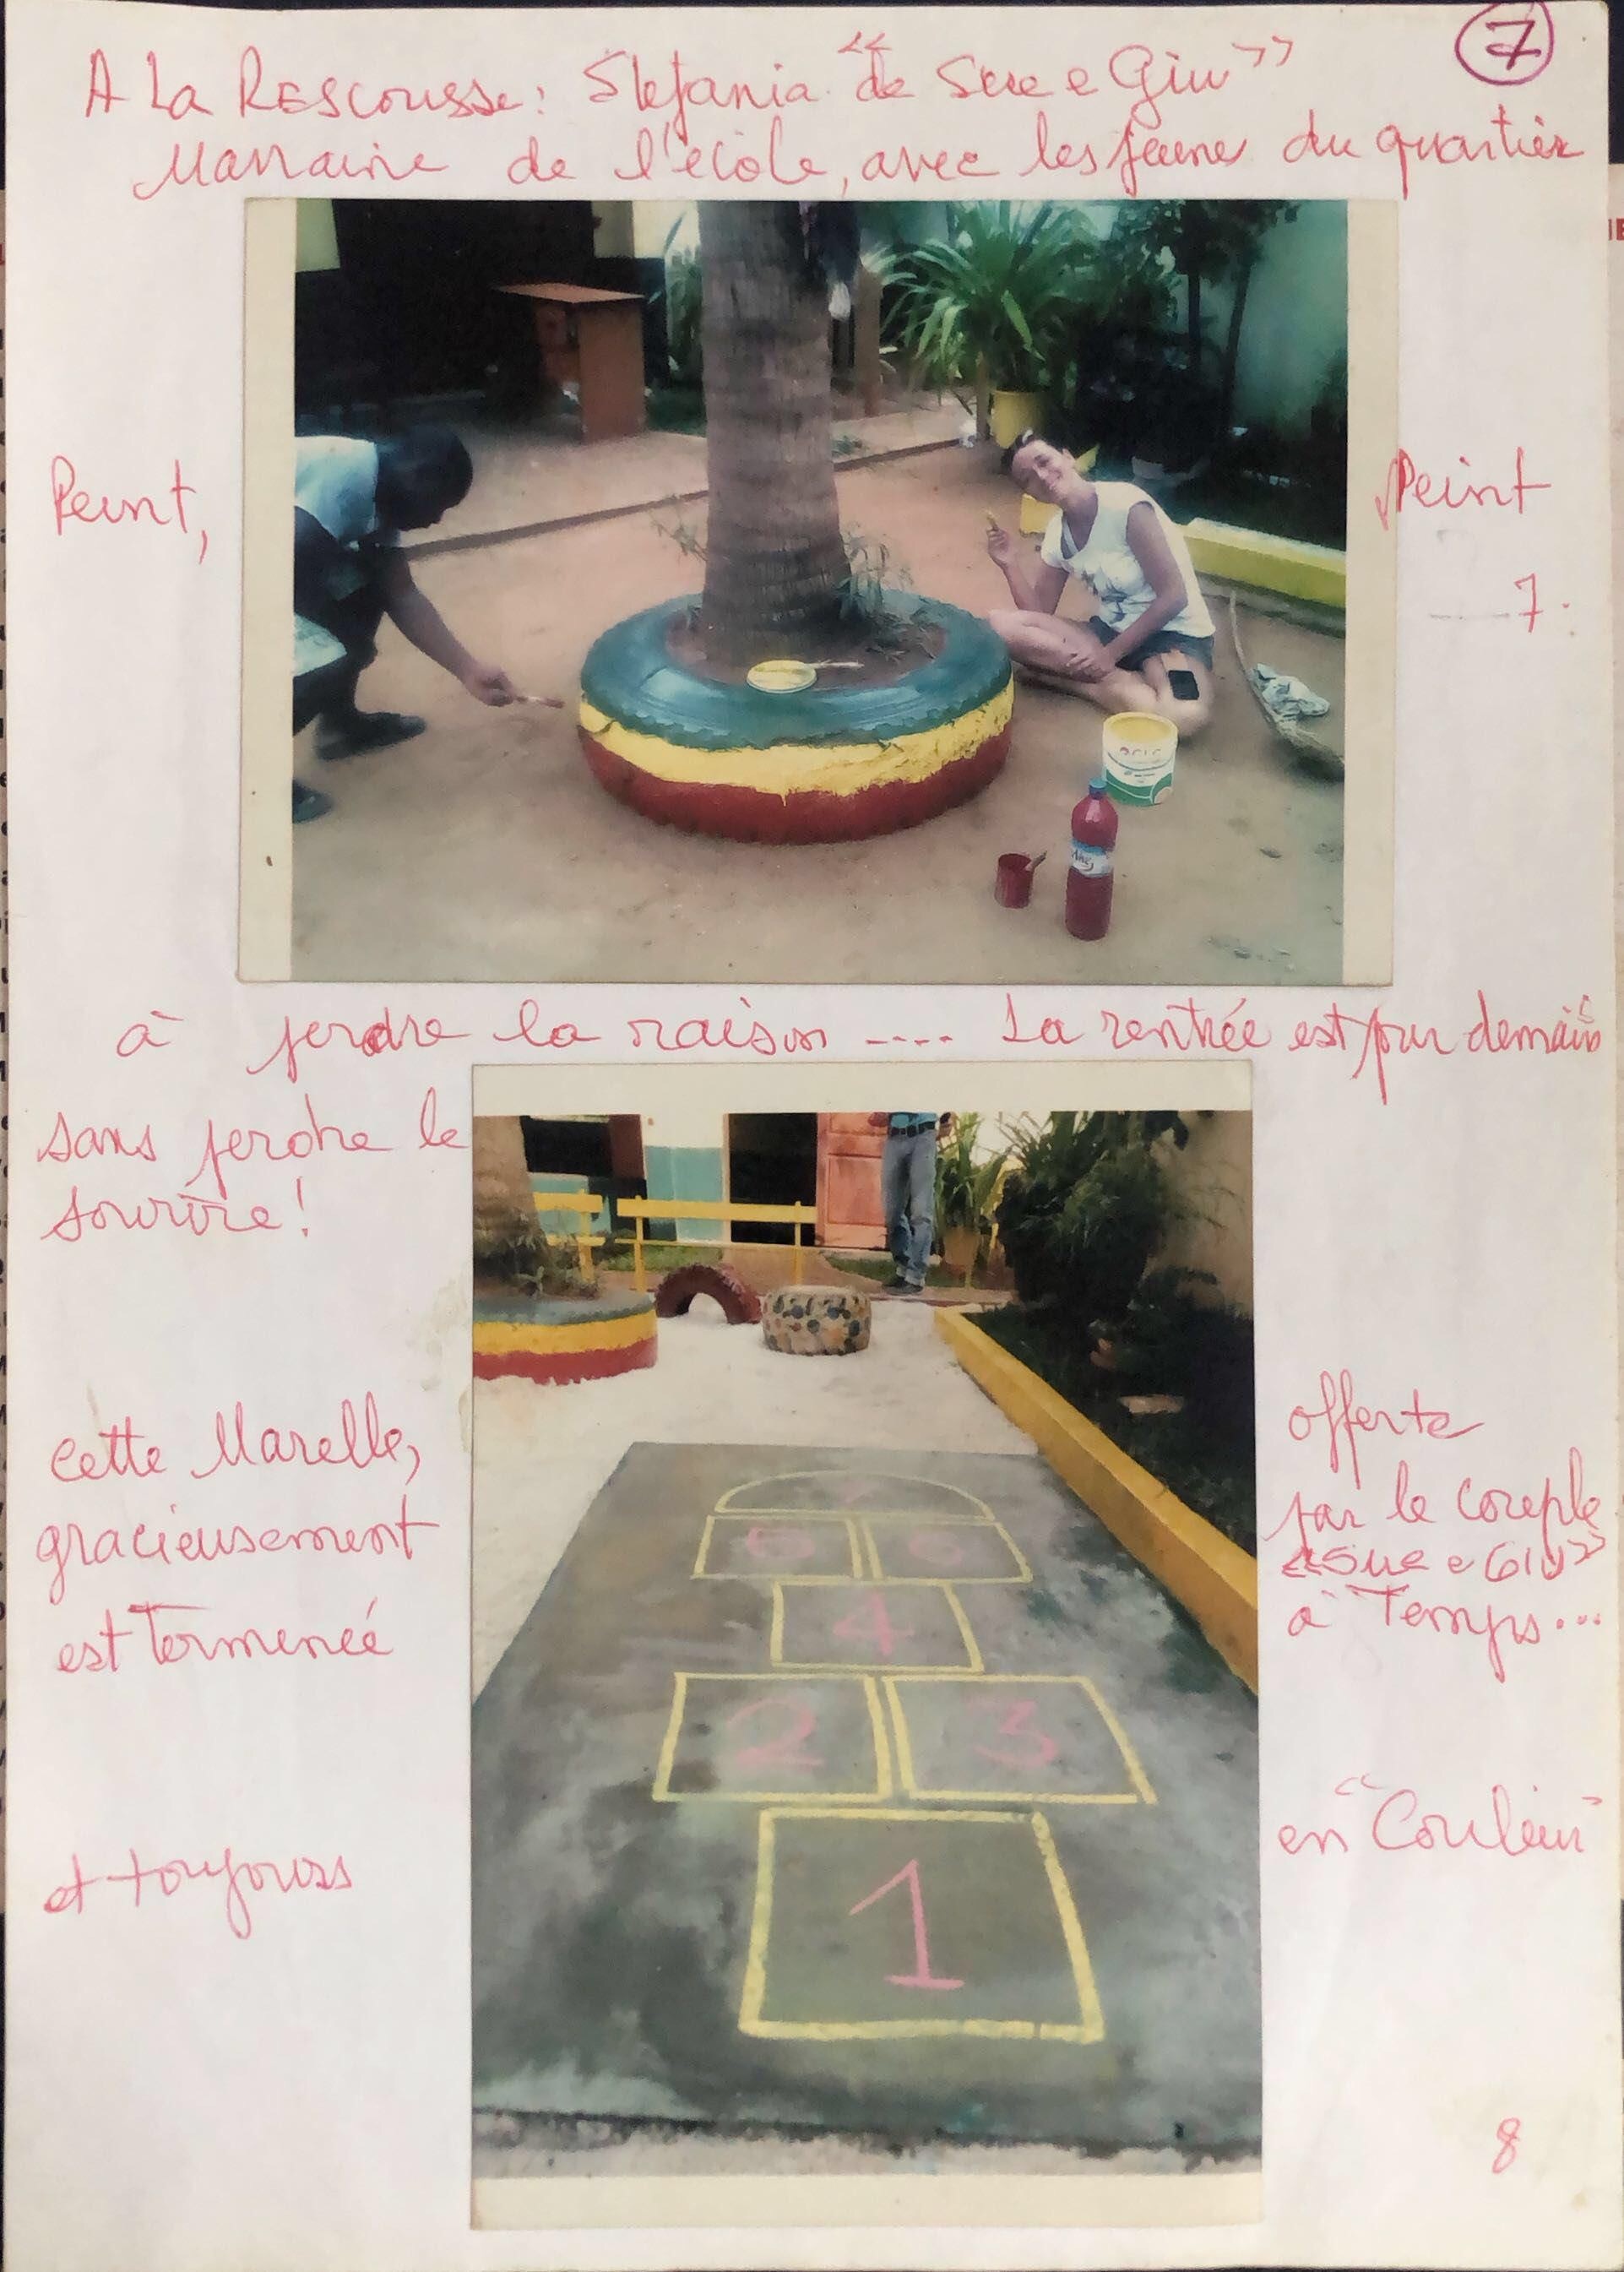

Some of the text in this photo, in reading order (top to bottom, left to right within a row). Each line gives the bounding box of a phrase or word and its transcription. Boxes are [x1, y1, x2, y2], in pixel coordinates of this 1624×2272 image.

[85, 48, 130, 118] A
[146, 50, 214, 121] La
[1065, 66, 1099, 96] e
[132, 140, 450, 201] Marraine
[507, 135, 577, 185] de
[861, 145, 1000, 182] avec
[1018, 110, 1098, 176] les
[1282, 108, 1362, 164] du
[1375, 103, 1585, 201] quartier
[117, 1010, 183, 1057] à
[247, 1006, 471, 1084] perdre
[493, 998, 600, 1047] la
[627, 997, 828, 1056] raison
[1002, 992, 1085, 1045] La
[1100, 997, 1273, 1052] rentrée
[1288, 1002, 1370, 1052] est
[36, 1085, 470, 1200] sans perdre le
[190, 1390, 422, 1487] Marelle,
[1288, 1368, 1485, 1490] offerte
[1262, 1491, 1366, 1558] par
[1386, 1459, 1436, 1524] le
[35, 1493, 440, 1605] gracieusement
[1447, 1555, 1475, 1574] e
[57, 1607, 133, 1673] est
[833, 1590, 915, 1658] 4
[1287, 1590, 1332, 1637] à
[725, 1696, 825, 1769] 2
[967, 1698, 1059, 1769] 3
[1278, 1824, 1350, 1856] en
[849, 1858, 964, 1990] 1
[1491, 2117, 1522, 2174] 8
